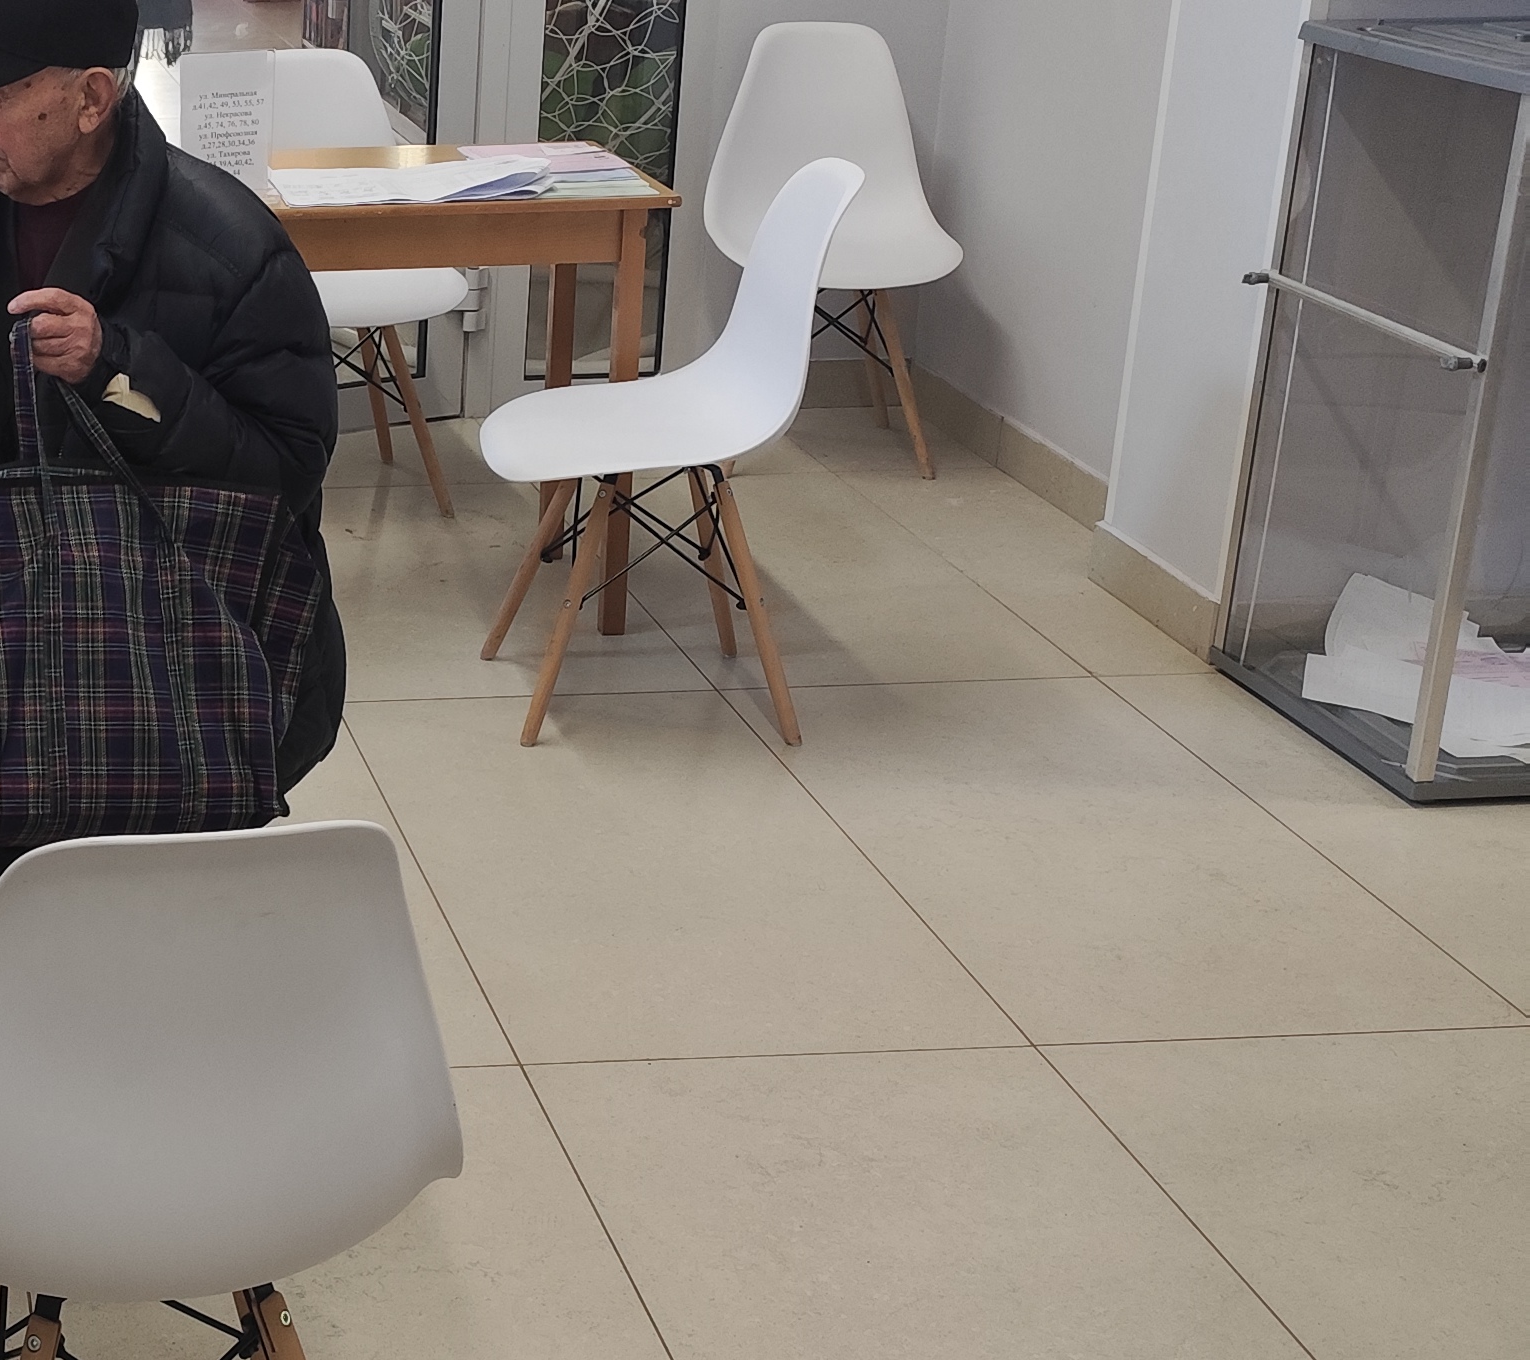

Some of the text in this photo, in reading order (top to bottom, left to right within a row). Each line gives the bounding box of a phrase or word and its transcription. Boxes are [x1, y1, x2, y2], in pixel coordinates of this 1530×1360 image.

[211, 90, 258, 99] Минеральная
[217, 110, 252, 119] Некрасова
[239, 120, 249, 128] 78,
[210, 130, 258, 140] Профсоюзная
[206, 150, 250, 159] ул. Тахирова
